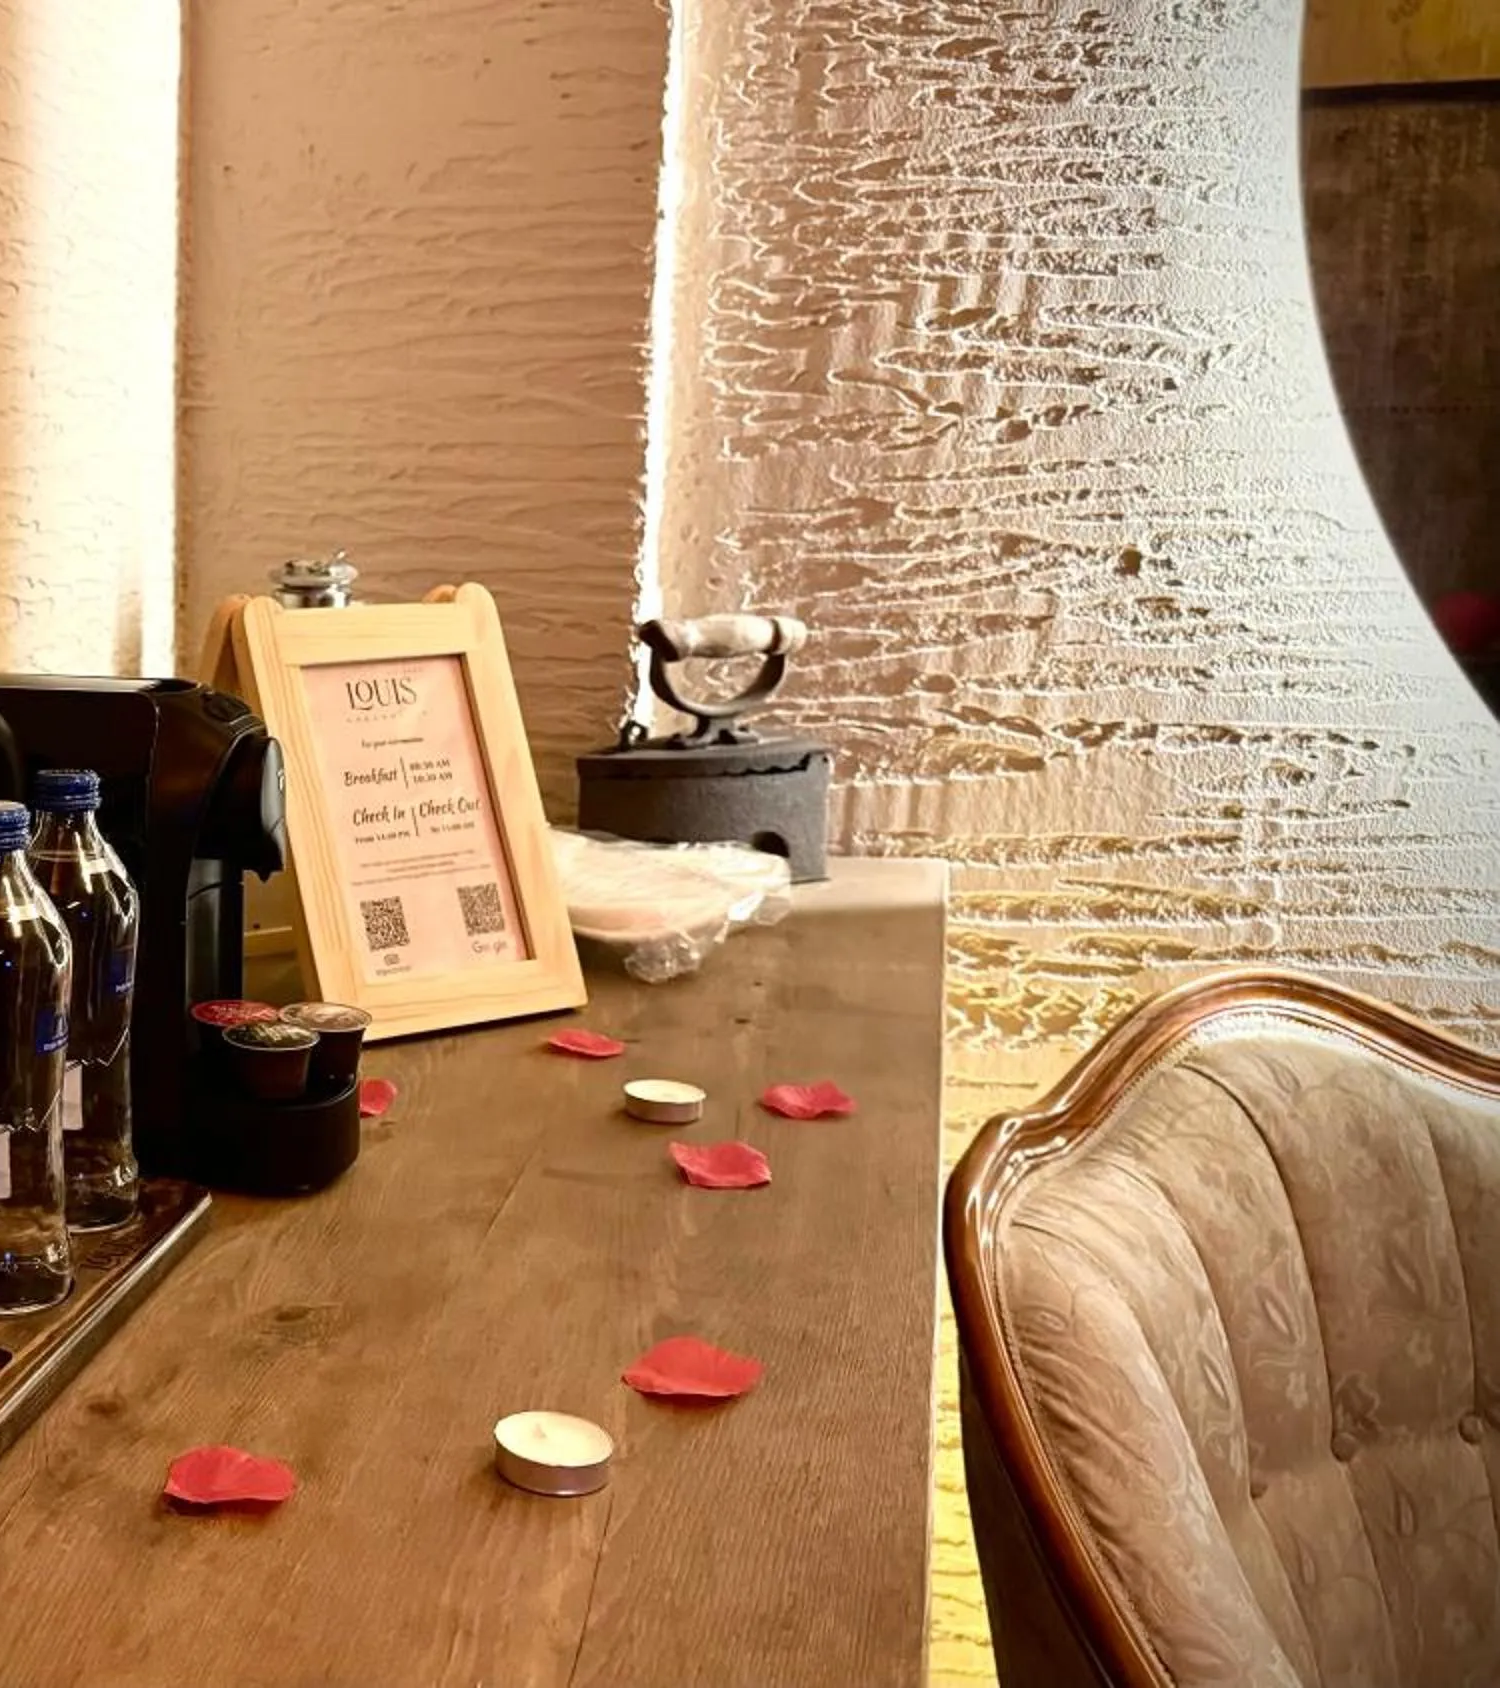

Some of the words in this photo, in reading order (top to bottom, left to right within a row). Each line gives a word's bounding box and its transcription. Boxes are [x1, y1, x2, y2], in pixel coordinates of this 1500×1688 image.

[346, 677, 418, 710] LOUIS
[344, 767, 398, 787] Breakfast
[353, 805, 391, 826] Check
[393, 805, 406, 821] In
[419, 798, 456, 818] Check
[457, 796, 481, 814] Out
[471, 940, 509, 955] Gogle
